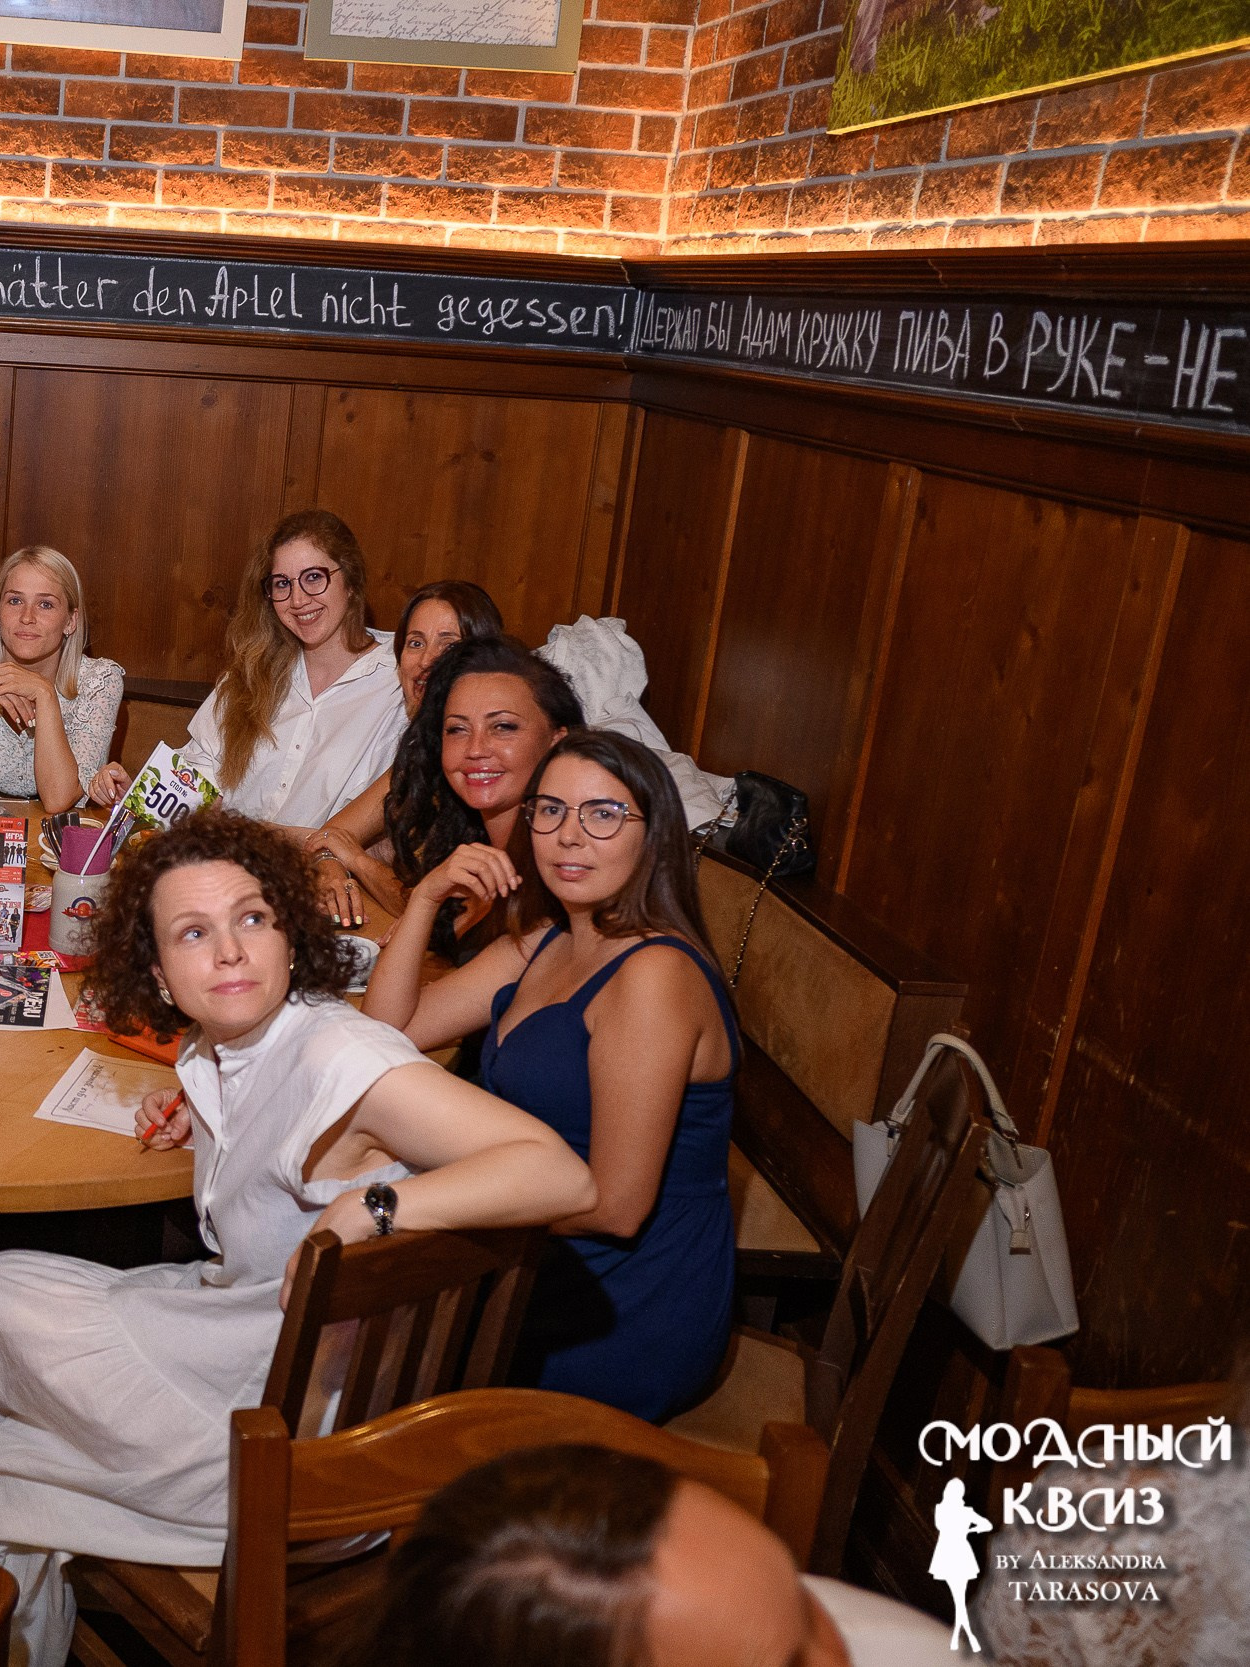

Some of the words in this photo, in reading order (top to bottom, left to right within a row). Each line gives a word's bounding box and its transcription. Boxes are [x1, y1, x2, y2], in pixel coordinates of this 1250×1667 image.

[133, 266, 197, 316] den
[321, 276, 413, 327] nicht
[437, 293, 628, 341] gegessen!
[704, 300, 733, 352] БЫ
[737, 295, 791, 357] АДАМ
[795, 308, 882, 374] КРУЖКУ
[893, 309, 970, 381] ПИВА
[983, 311, 1010, 380] В
[1022, 310, 1138, 400] РУКЕ
[1171, 317, 1248, 413] НЕ
[169, 780, 183, 793] СТОЛ
[5, 832, 24, 840] ИГРА
